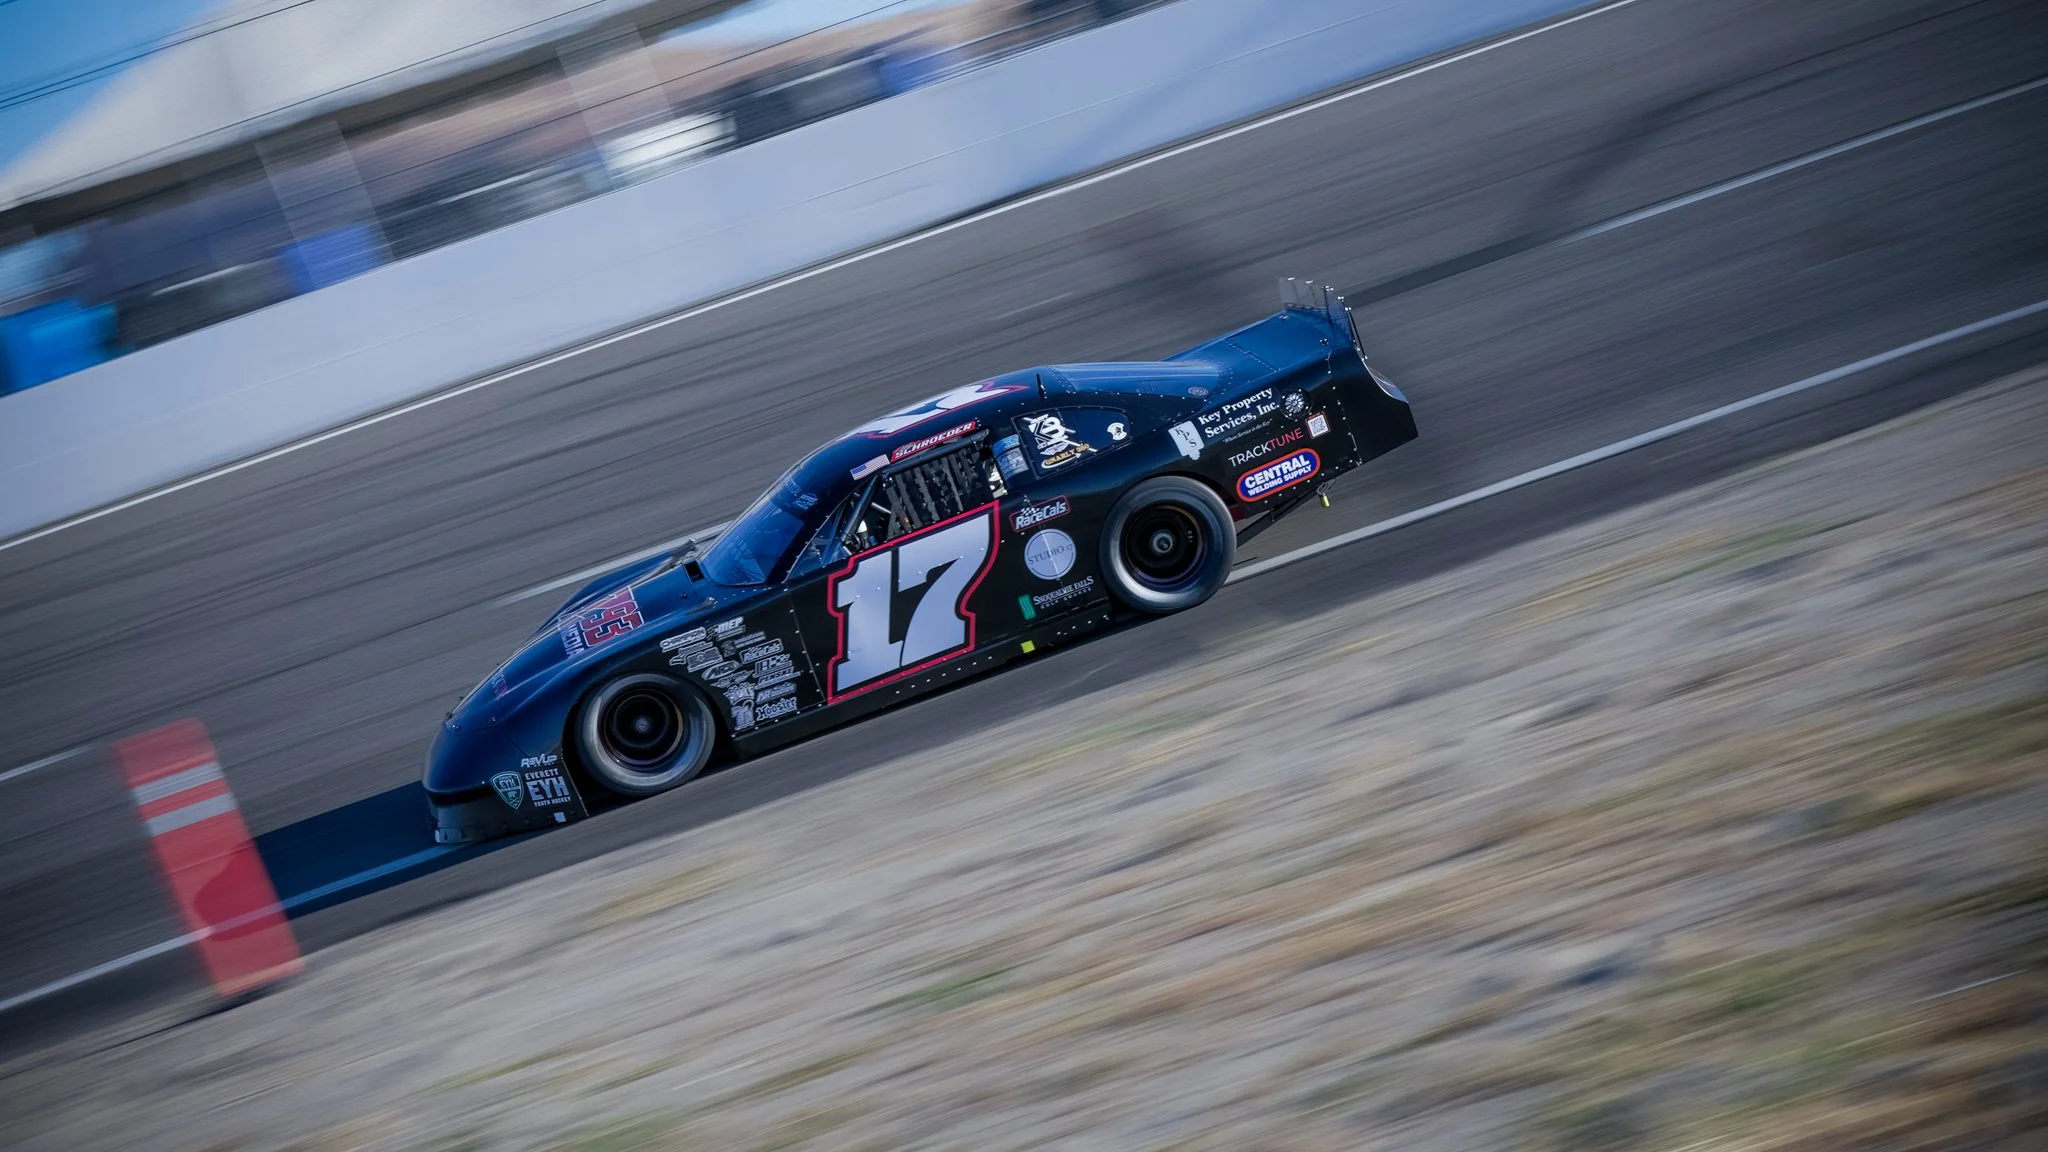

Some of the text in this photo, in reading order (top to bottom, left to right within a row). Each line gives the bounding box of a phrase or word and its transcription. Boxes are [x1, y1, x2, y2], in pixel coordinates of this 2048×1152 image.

[1198, 409, 1221, 426] Key
[1222, 388, 1273, 415] Property
[1204, 401, 1280, 438] Services, Inc.
[895, 423, 973, 458] SCHROEDER
[1228, 427, 1304, 467] TRACKTUNE
[1045, 449, 1076, 465] GNARLY
[1244, 454, 1310, 489] CENTRAL
[1247, 464, 1312, 497] WELDING SUPPLY
[1015, 501, 1067, 530] RaceCals
[1028, 544, 1065, 565] STUDIO
[1073, 575, 1094, 591] FALLS
[837, 513, 990, 692] 17
[743, 642, 781, 661] RaceCals
[756, 697, 797, 720] Hoosier
[499, 778, 516, 788] EYH
[525, 768, 558, 780] EVERETT
[526, 776, 570, 801] EYH
